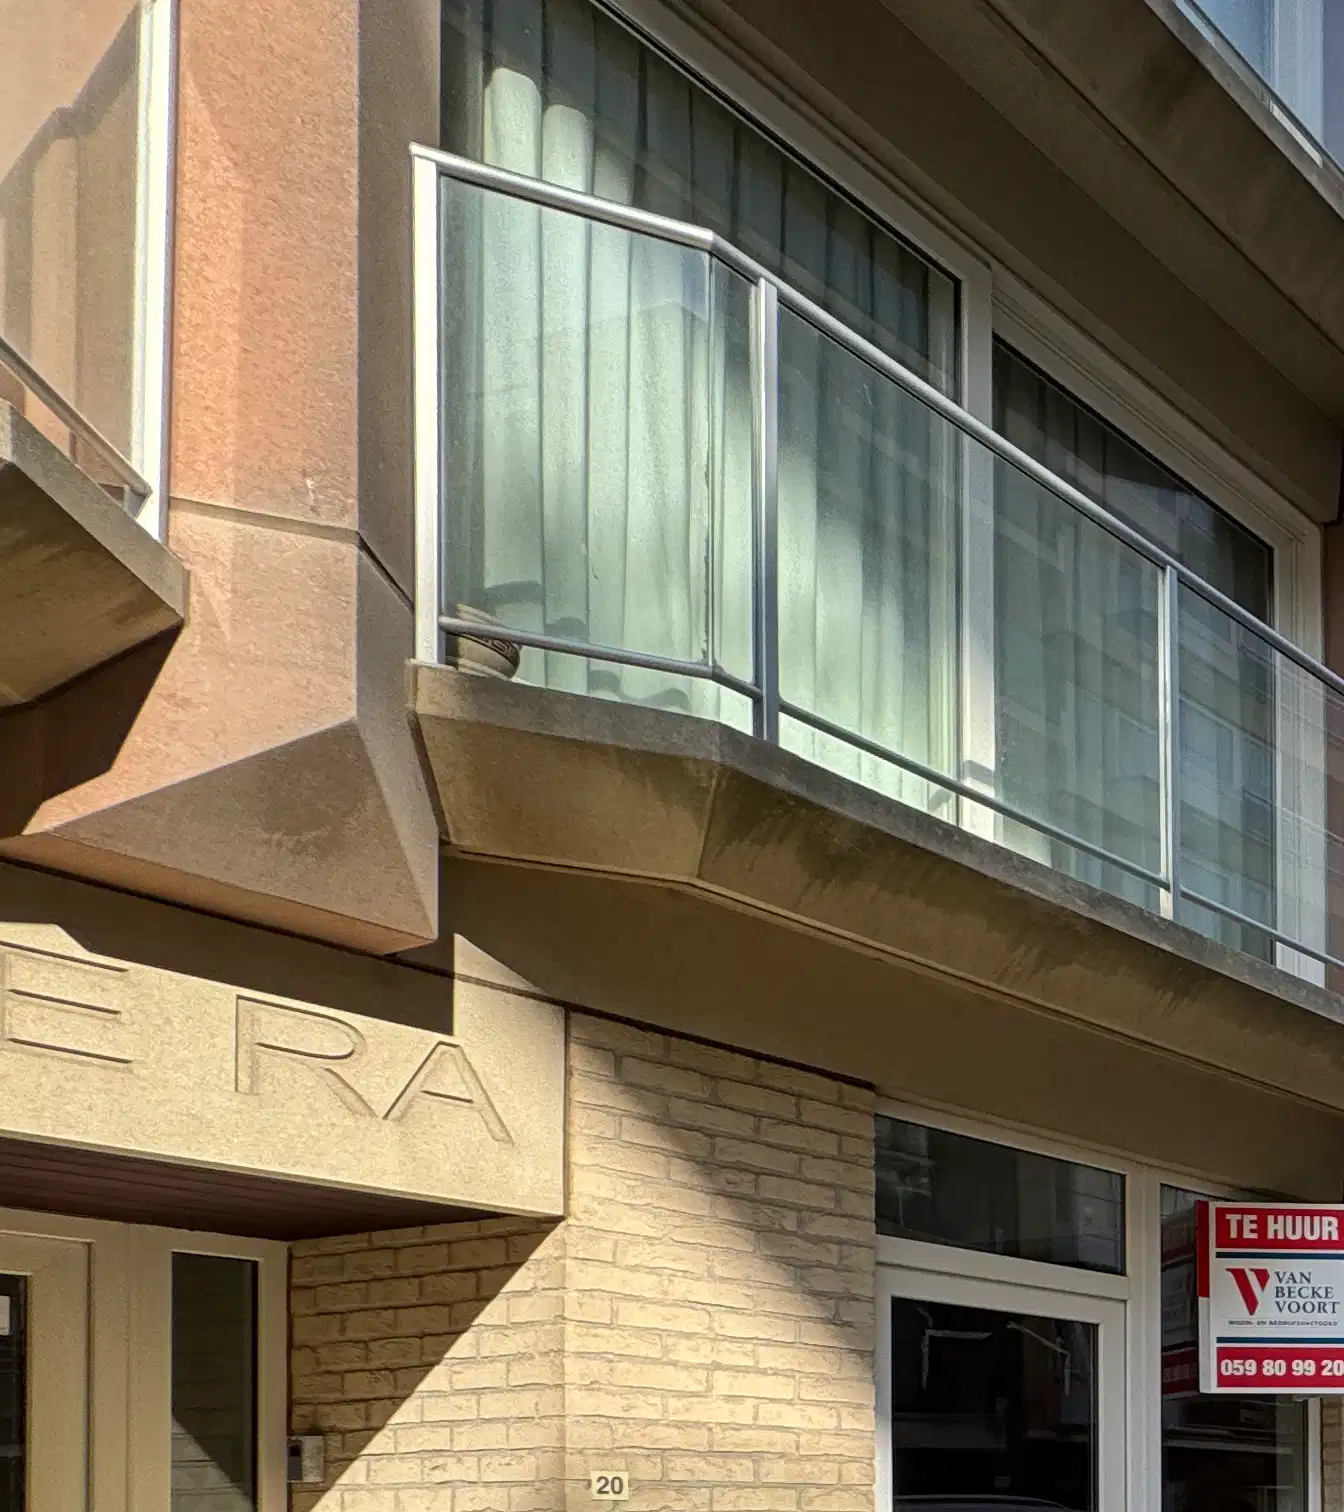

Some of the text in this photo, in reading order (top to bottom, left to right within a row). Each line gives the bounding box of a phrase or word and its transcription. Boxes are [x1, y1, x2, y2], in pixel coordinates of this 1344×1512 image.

[1225, 1213, 1340, 1241] TE HUUR
[1274, 1271, 1312, 1284] VAN
[1274, 1286, 1334, 1299] BECKE
[1274, 1301, 1341, 1314] VOORT
[1220, 1360, 1257, 1376] 059
[1262, 1360, 1287, 1376] 80
[1291, 1360, 1317, 1376] 99
[596, 1476, 624, 1494] 20
